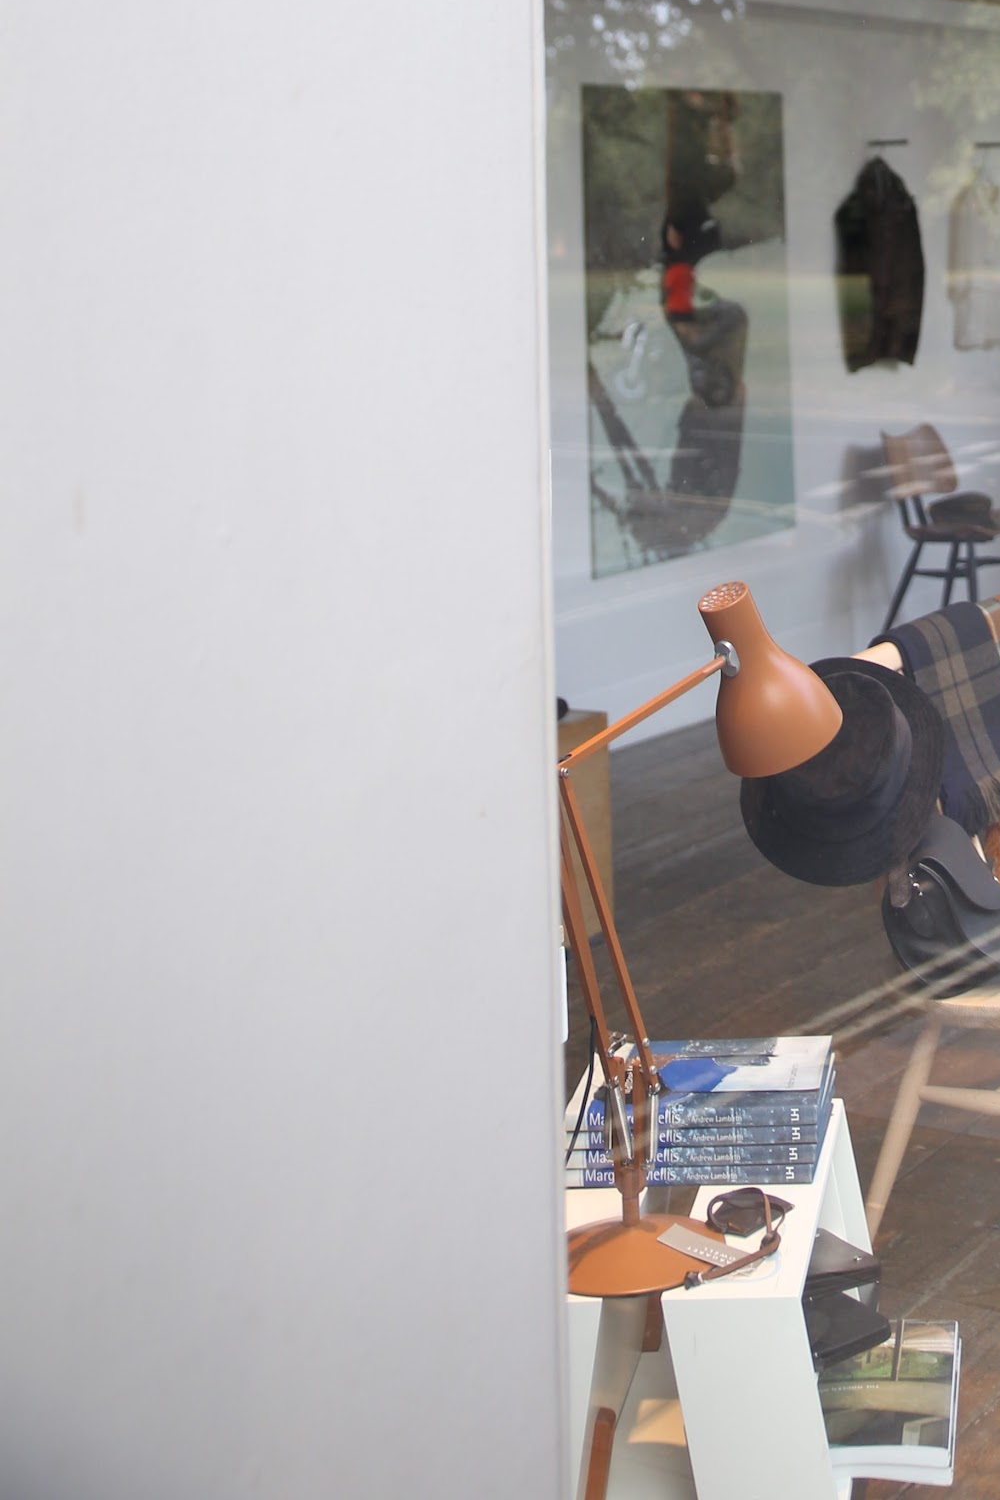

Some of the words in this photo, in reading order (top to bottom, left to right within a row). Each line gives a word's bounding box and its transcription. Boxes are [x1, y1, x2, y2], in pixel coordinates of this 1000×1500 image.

[658, 1108, 681, 1124] ellis
[691, 1115, 714, 1123] Andrew
[659, 1128, 682, 1143] ellis
[692, 1134, 715, 1142] Andrew
[656, 1148, 679, 1163] ellis
[689, 1154, 713, 1162] Andrew
[686, 1172, 710, 1180] Andrew
[687, 1246, 732, 1264] ARGARET
[704, 1247, 736, 1261] OWELL
